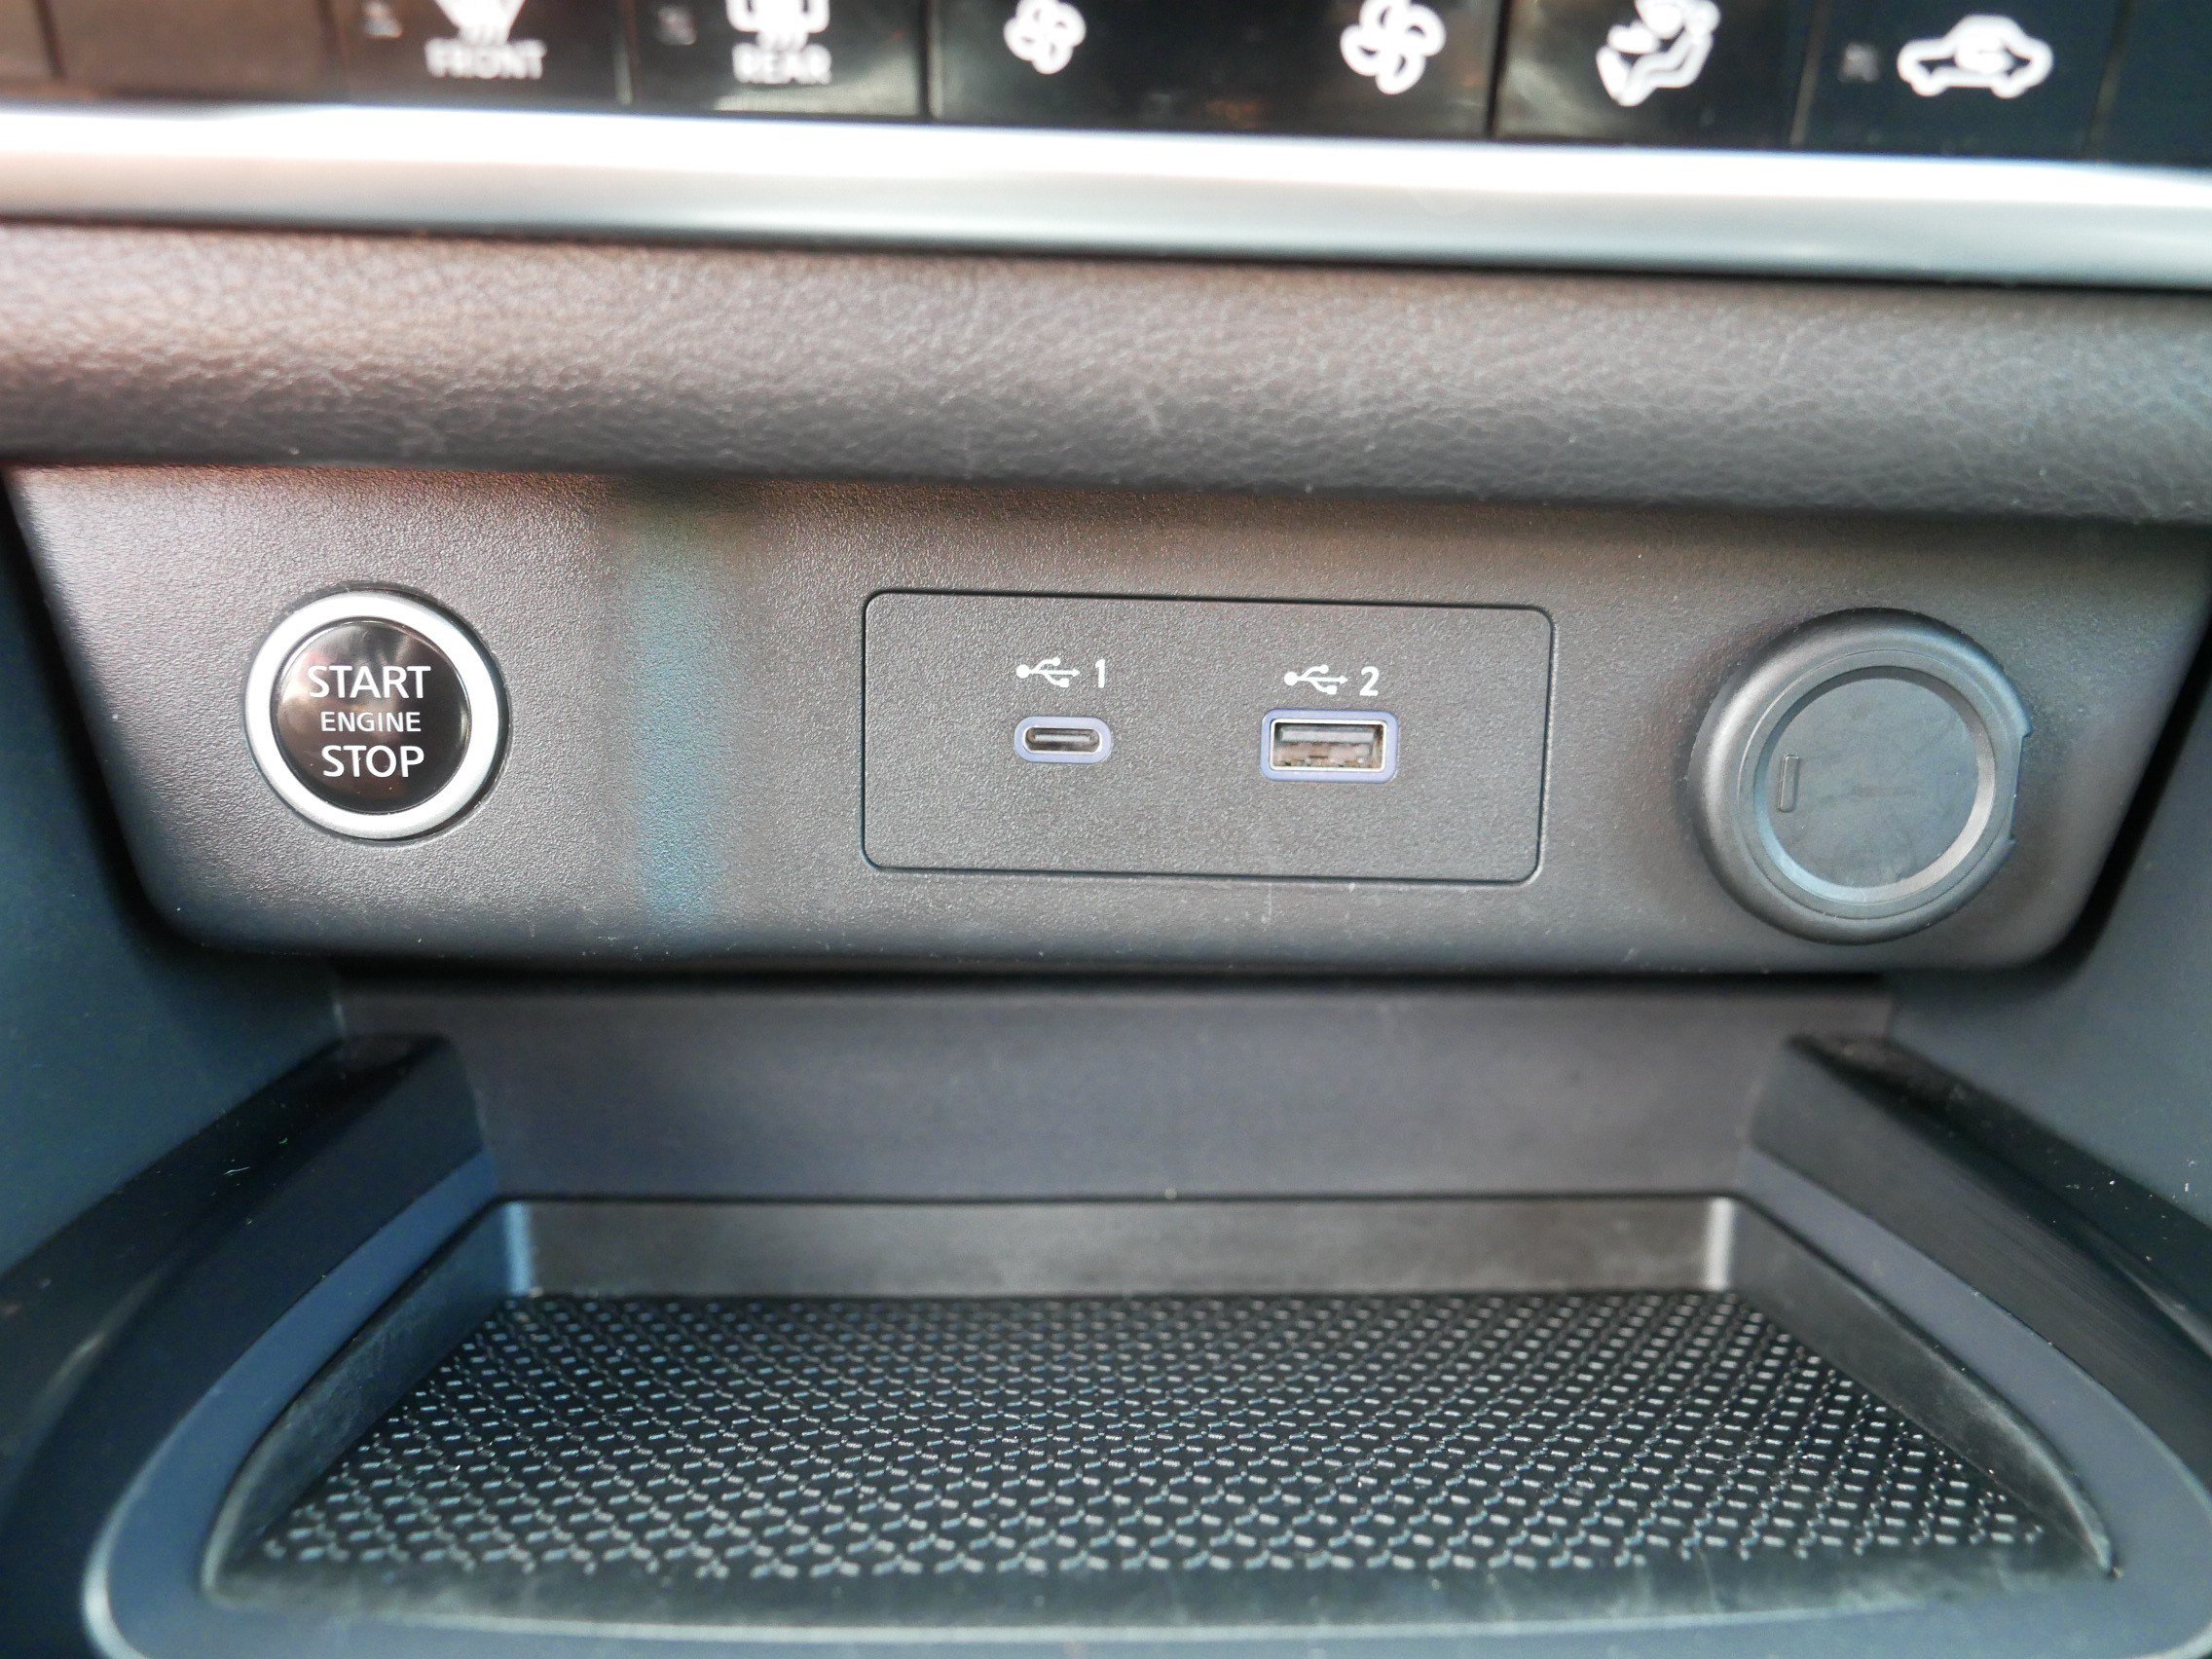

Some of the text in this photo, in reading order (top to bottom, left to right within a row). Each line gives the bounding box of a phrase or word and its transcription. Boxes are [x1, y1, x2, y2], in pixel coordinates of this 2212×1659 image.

[424, 38, 545, 80] FRONT
[732, 45, 832, 86] REAR
[308, 665, 431, 699] START
[1095, 658, 1106, 688] 1
[1359, 666, 1381, 697] 2
[320, 711, 422, 732] ENGINE
[320, 745, 424, 778] STOP
